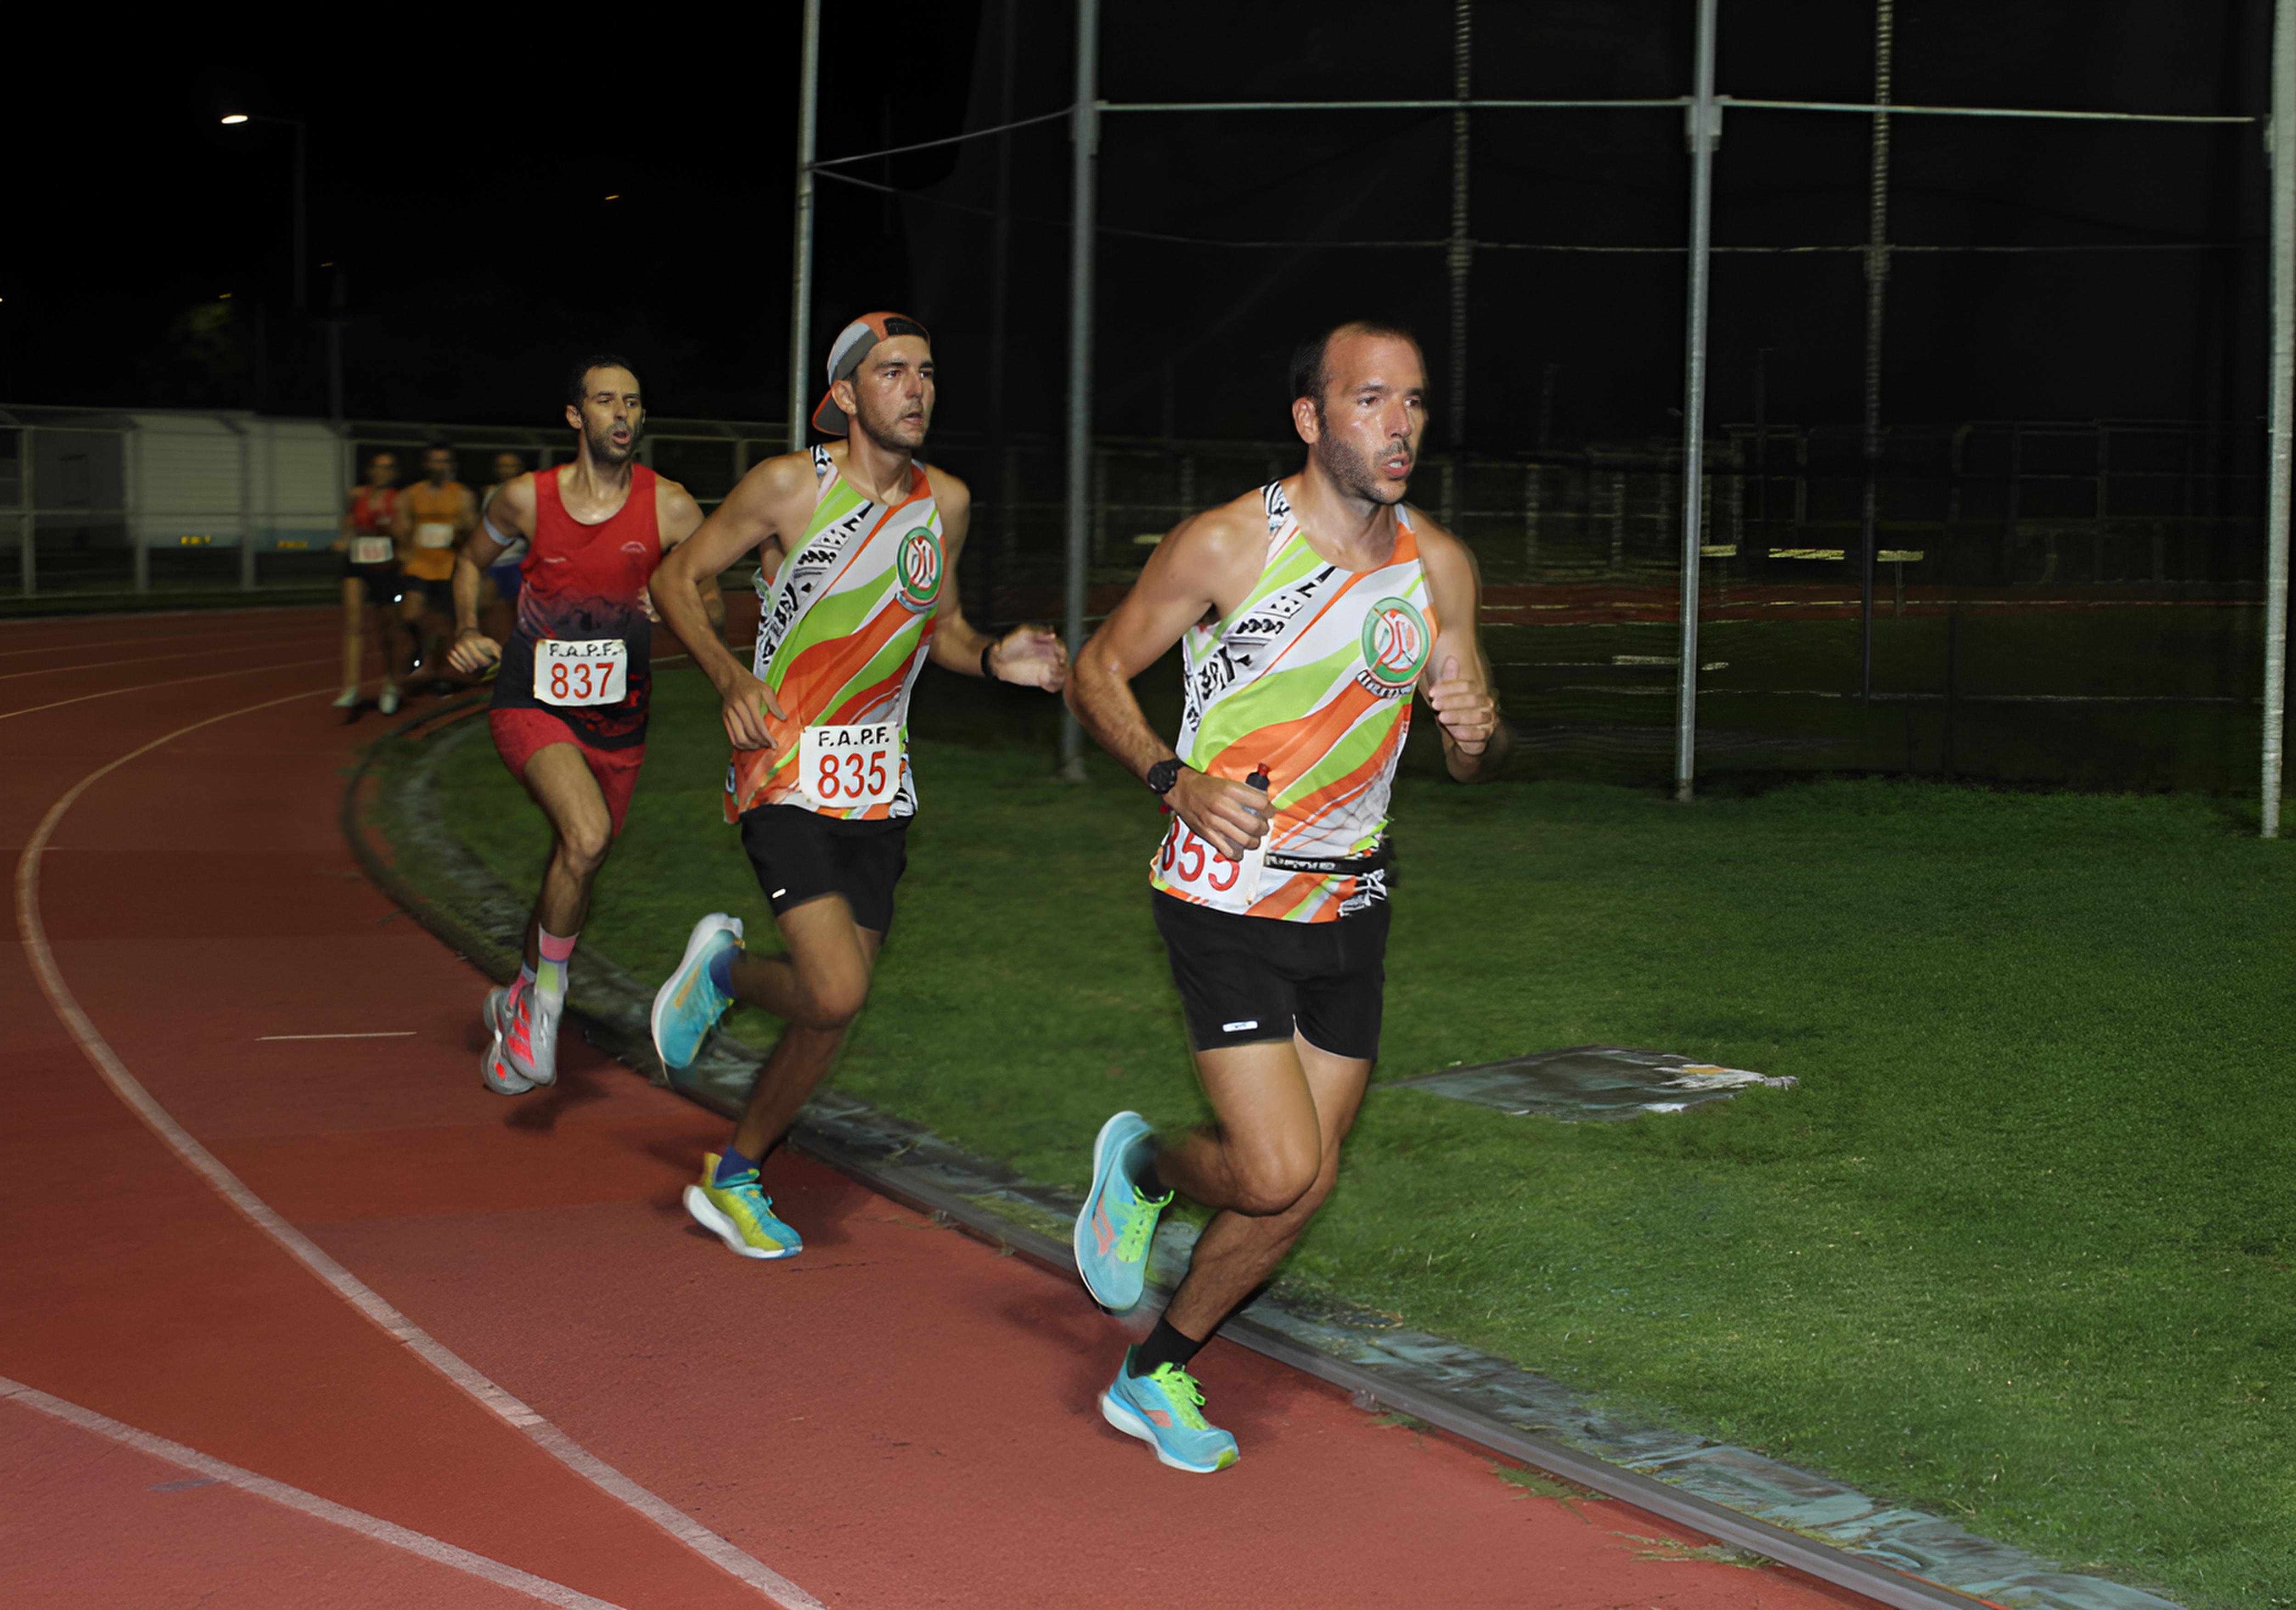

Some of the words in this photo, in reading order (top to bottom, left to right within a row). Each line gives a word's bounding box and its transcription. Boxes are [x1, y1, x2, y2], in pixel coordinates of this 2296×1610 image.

[549, 641, 618, 656] F.A.P.F.
[551, 662, 614, 699] 837
[818, 726, 889, 747] F.A.P.F.
[817, 750, 886, 799] 835
